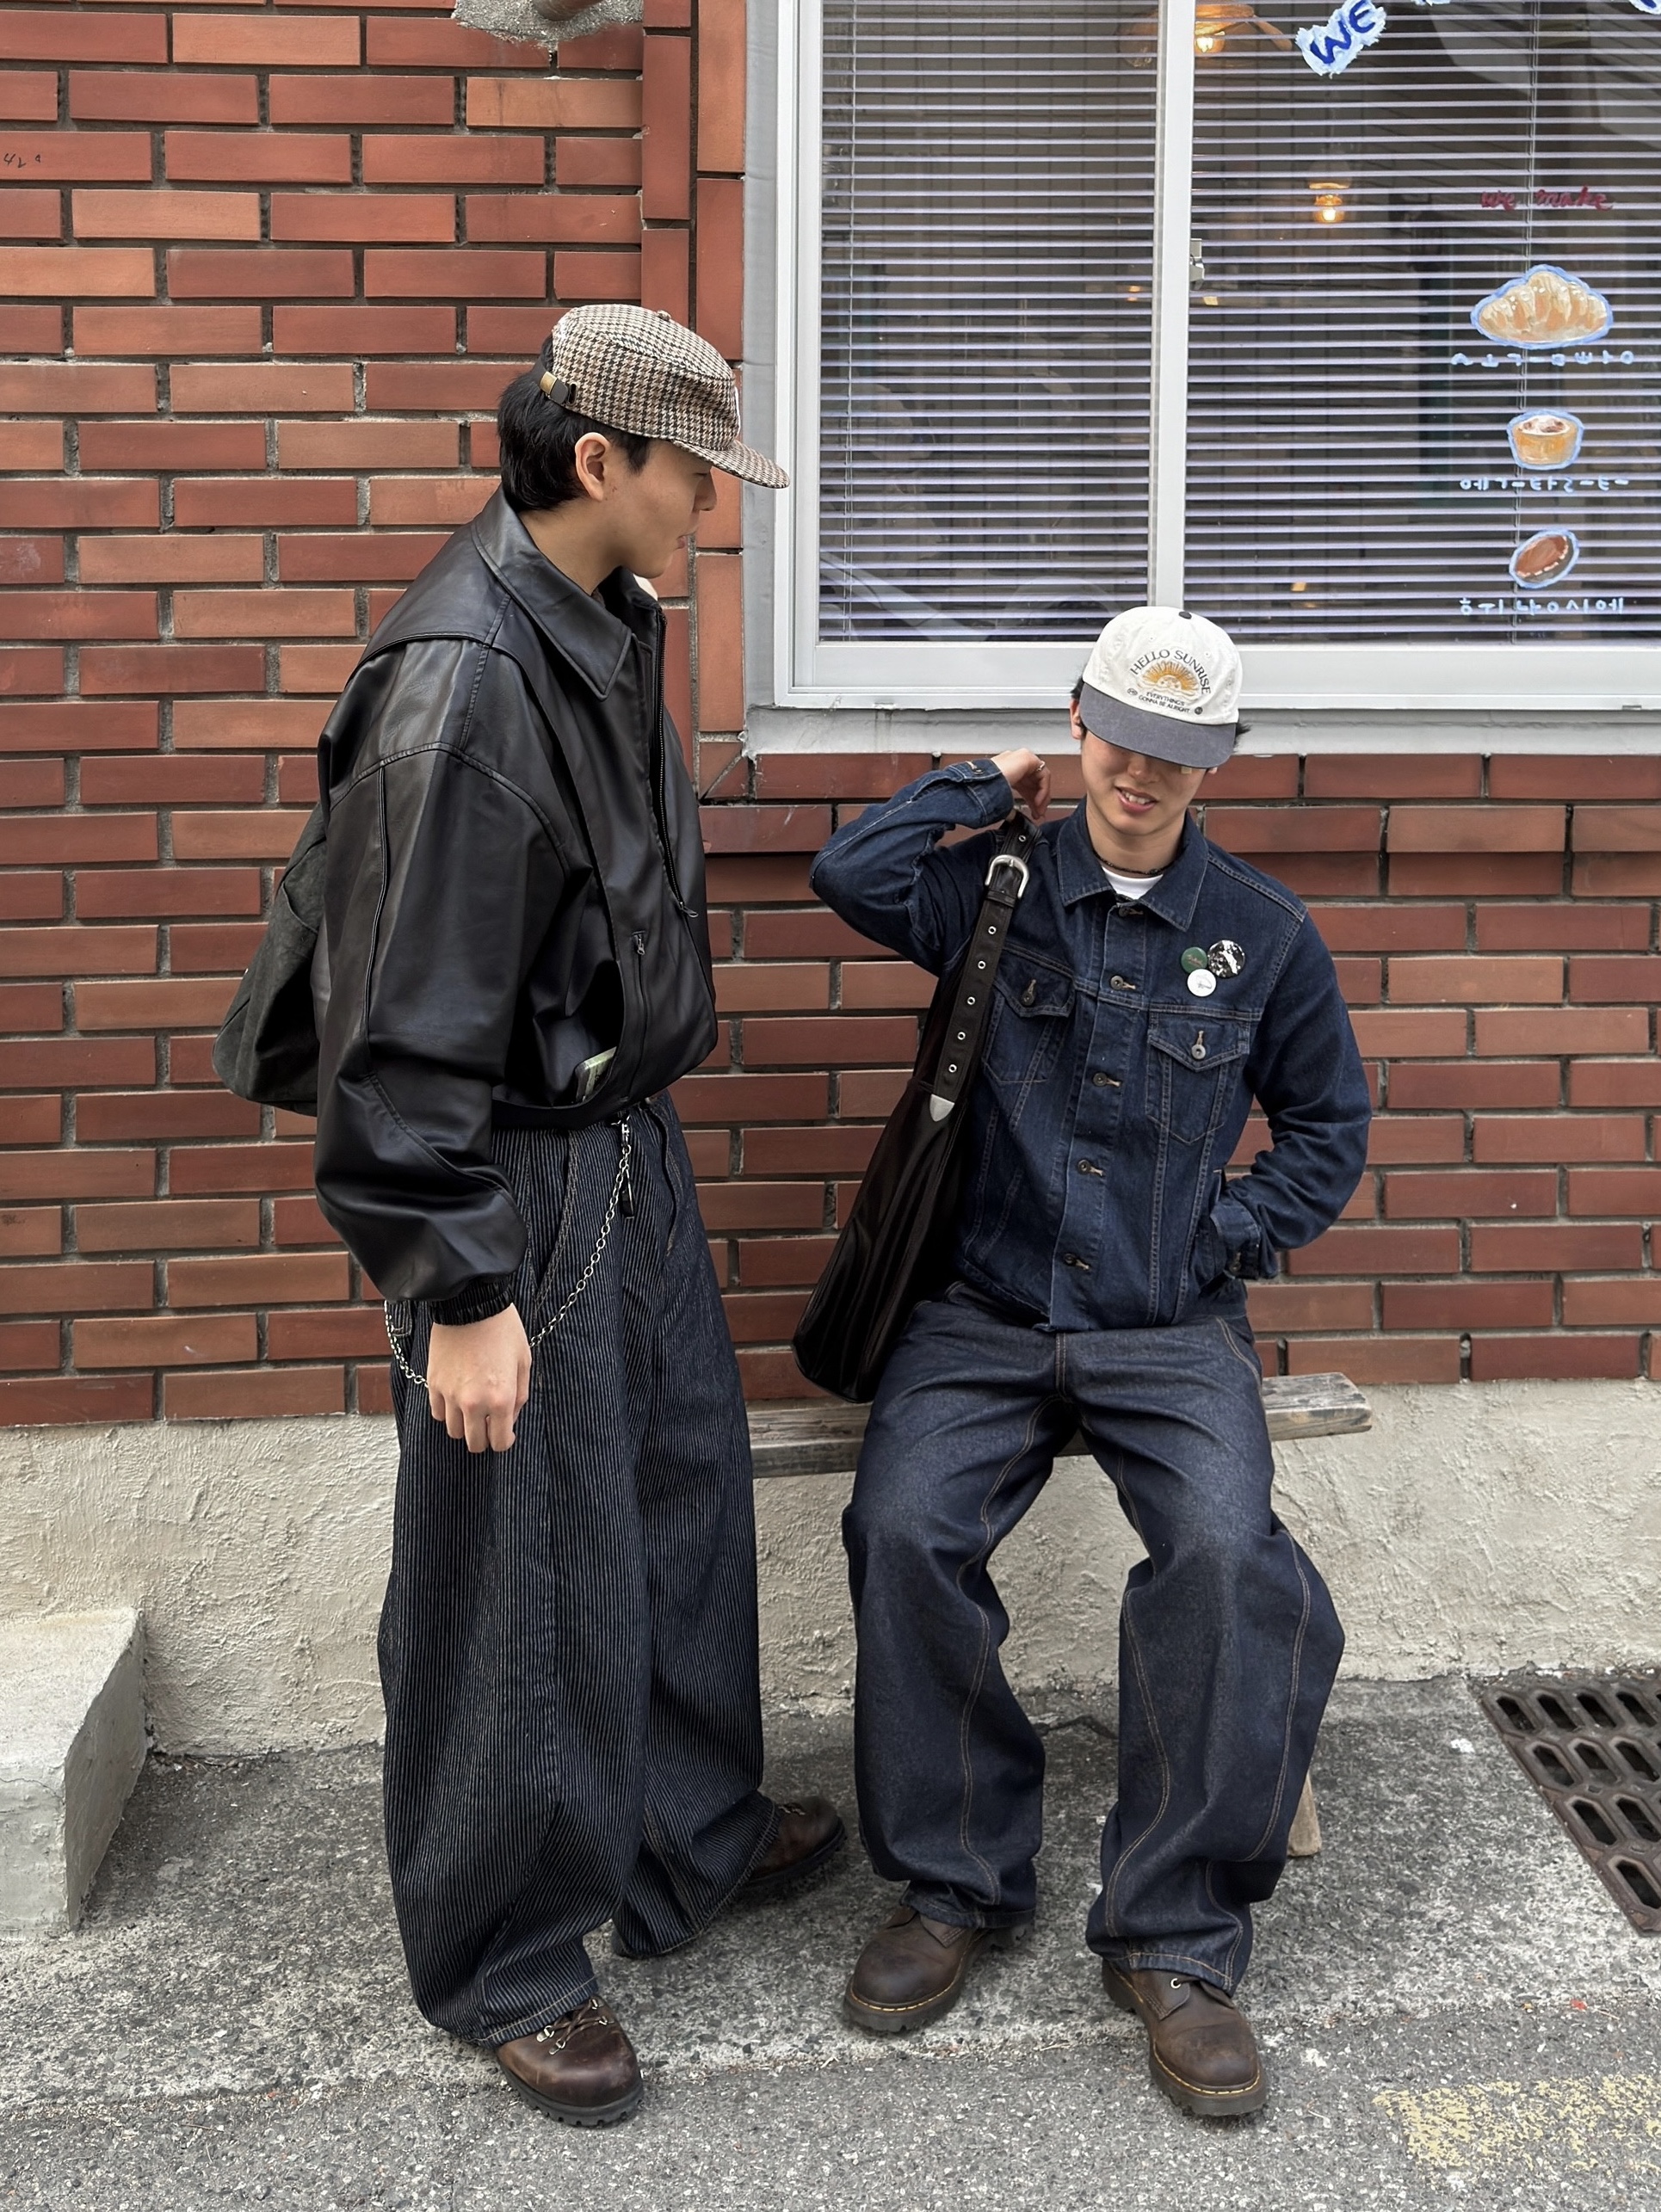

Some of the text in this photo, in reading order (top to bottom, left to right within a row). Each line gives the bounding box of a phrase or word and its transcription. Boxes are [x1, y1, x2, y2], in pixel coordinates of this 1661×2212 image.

[1310, 0, 1376, 65] WE
[1481, 185, 1614, 212] we make
[1130, 649, 1212, 695] HELLO SUNRISE
